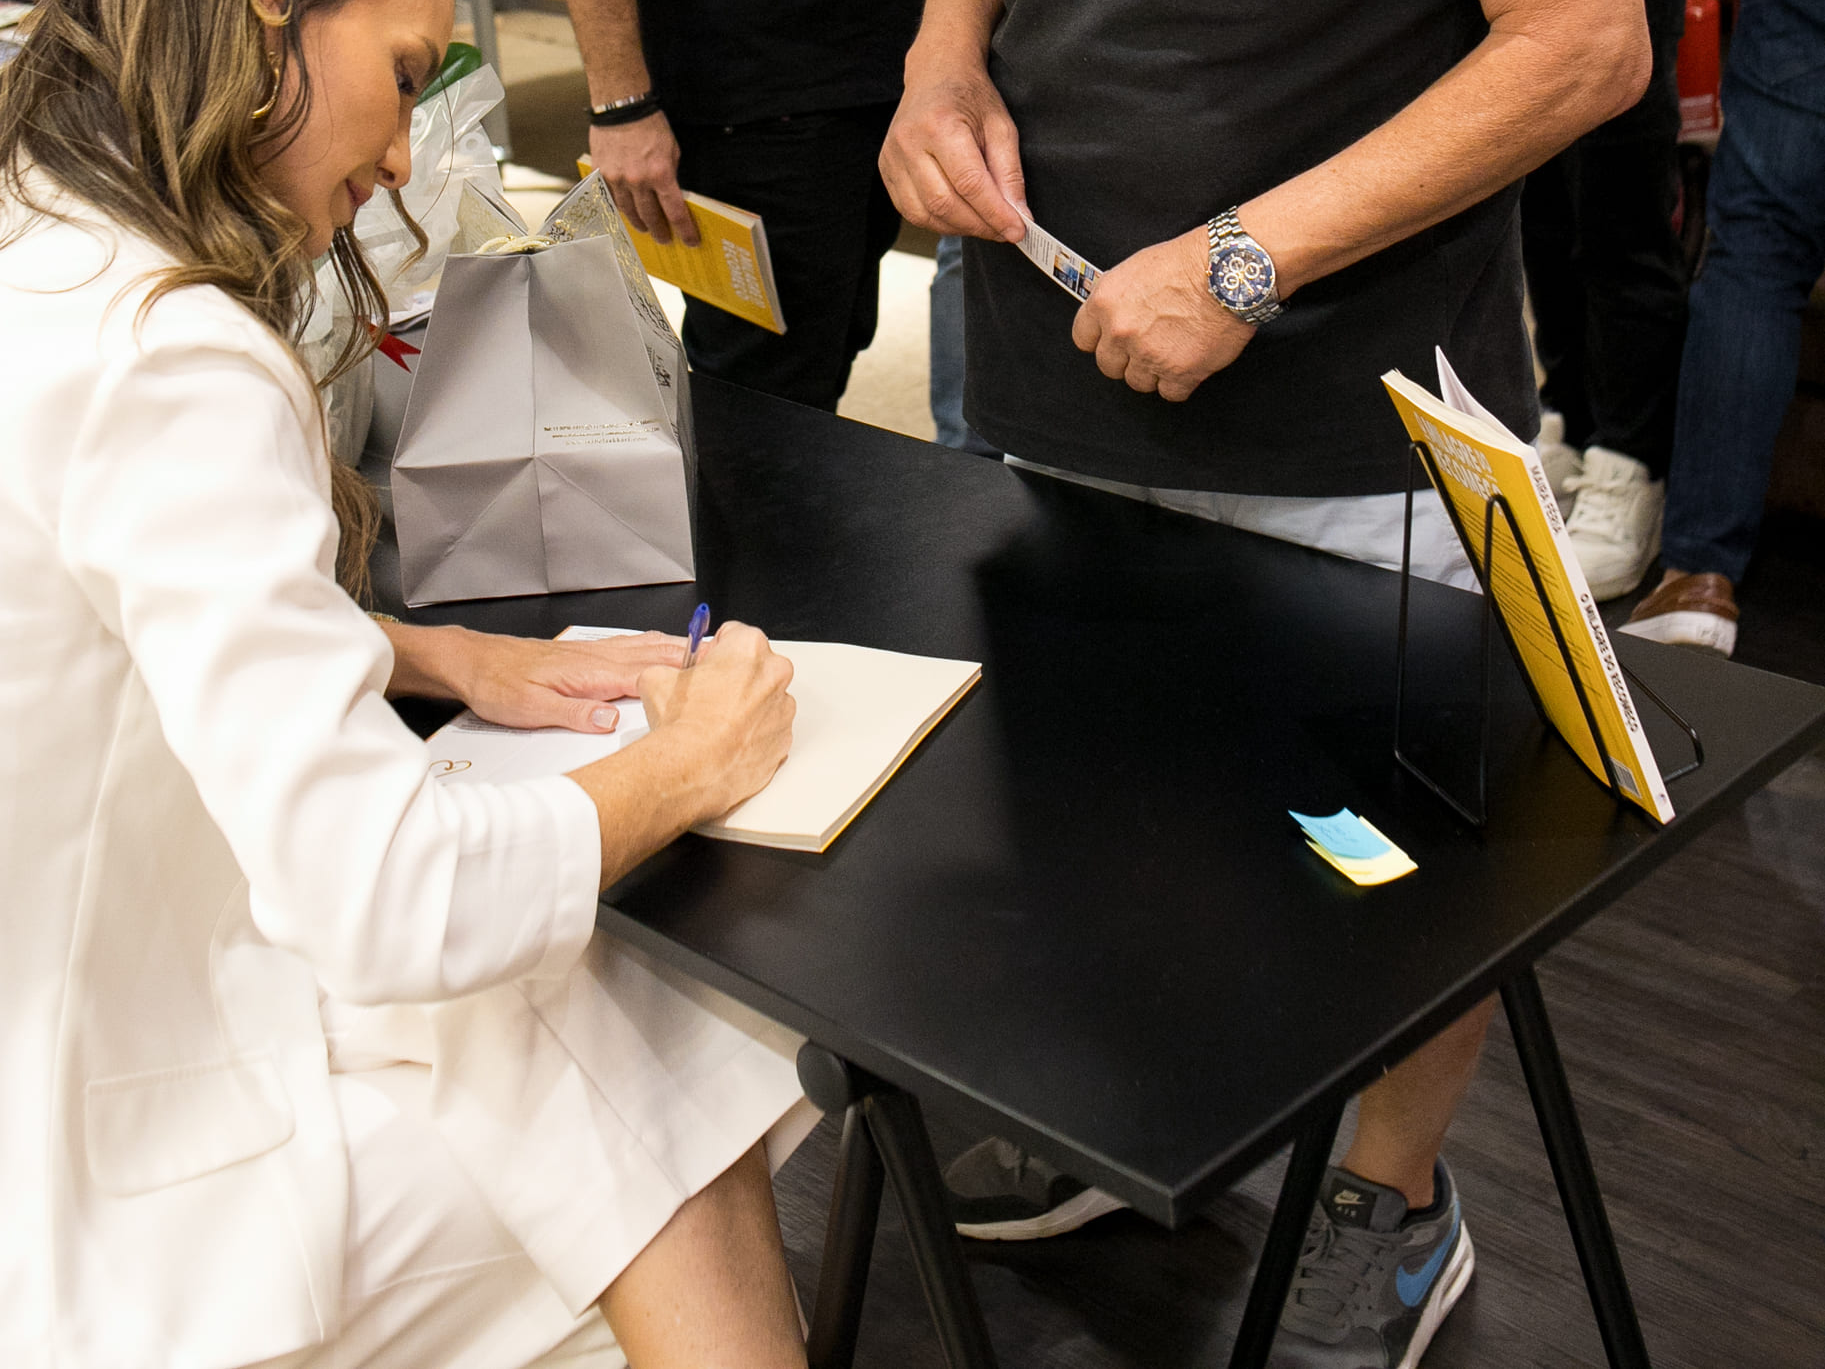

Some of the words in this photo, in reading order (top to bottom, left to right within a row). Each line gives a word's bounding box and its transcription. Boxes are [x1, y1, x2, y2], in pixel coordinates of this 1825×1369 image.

[1580, 593, 1589, 603] O
[1584, 604, 1608, 654] MILAGRE
[1604, 654, 1615, 671] DO
